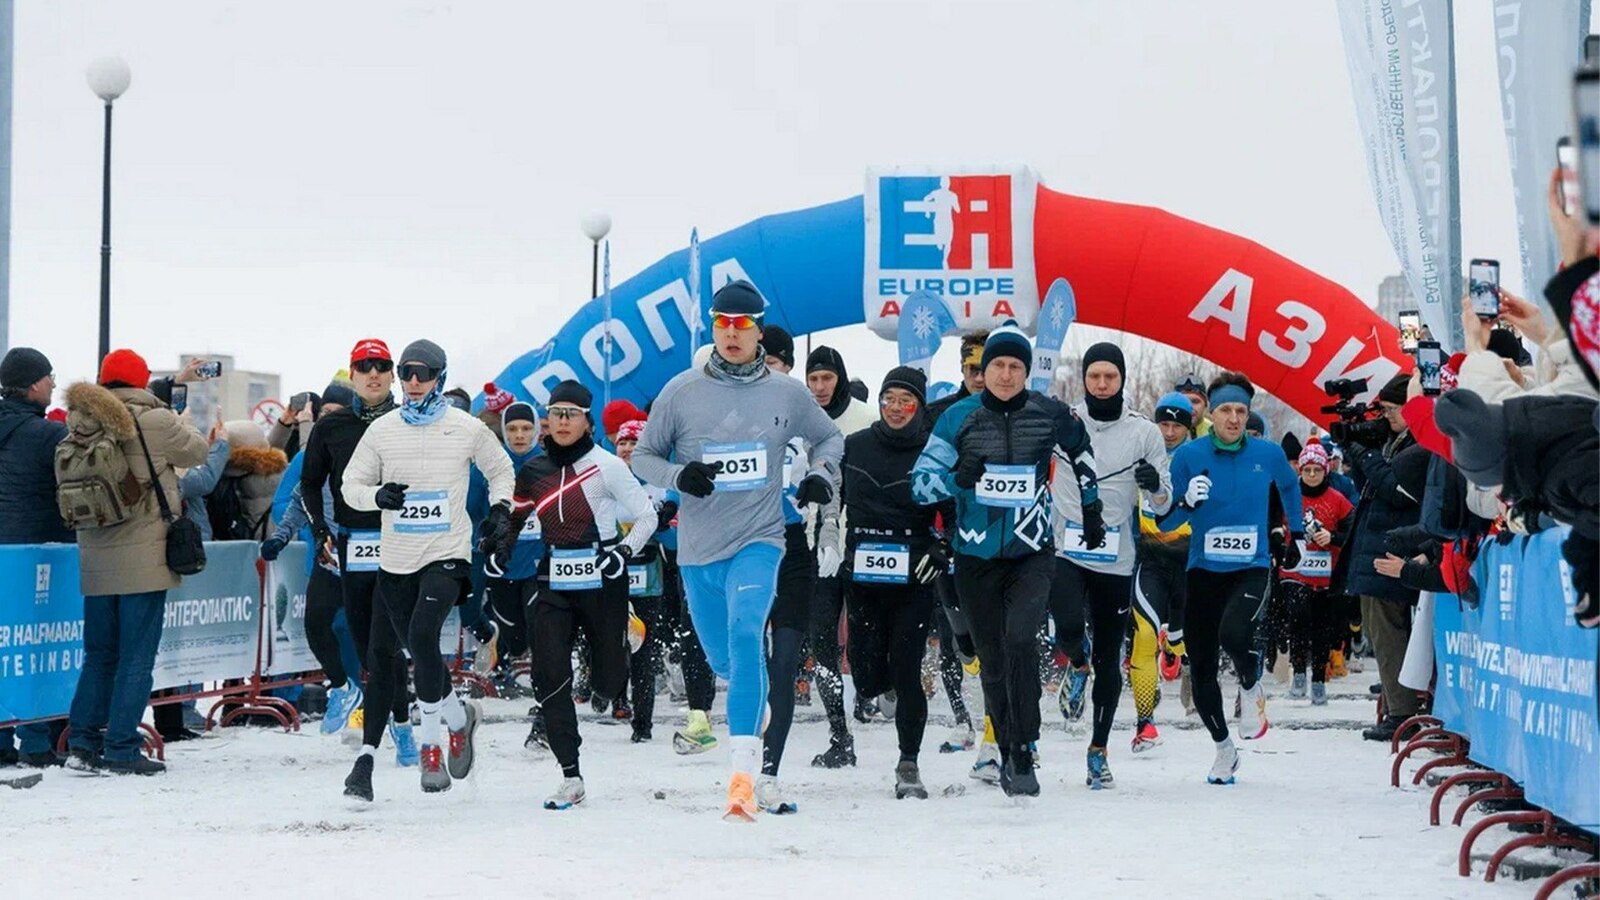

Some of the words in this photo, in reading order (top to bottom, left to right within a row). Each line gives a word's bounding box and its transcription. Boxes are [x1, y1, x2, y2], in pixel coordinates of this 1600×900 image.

[879, 277, 1014, 296] EUROPE
[880, 300, 1015, 318] AIA
[715, 457, 758, 475] 2031
[984, 479, 1028, 493] 3073
[399, 505, 442, 519] 2294
[1212, 537, 1251, 550] 2526
[866, 555, 897, 569] 540
[555, 562, 594, 577] 3058
